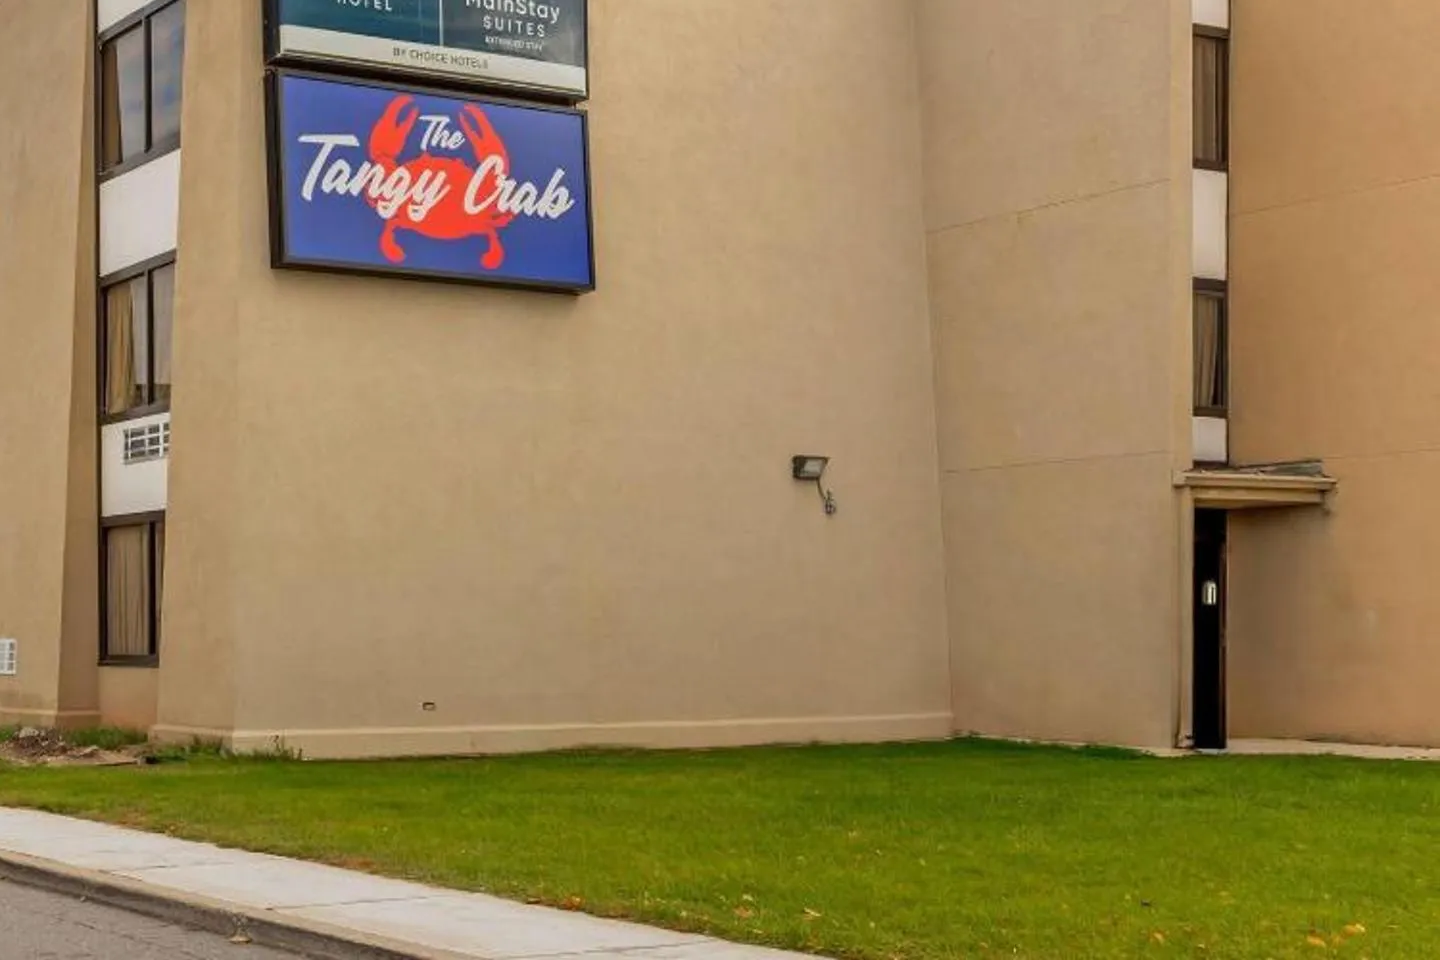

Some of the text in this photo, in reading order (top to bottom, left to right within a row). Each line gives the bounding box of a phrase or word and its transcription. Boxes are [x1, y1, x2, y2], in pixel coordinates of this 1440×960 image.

[483, 15, 545, 38] SUITES
[409, 48, 448, 64] CHOICE
[418, 114, 466, 151] The
[298, 134, 575, 223] Tangy Crab
